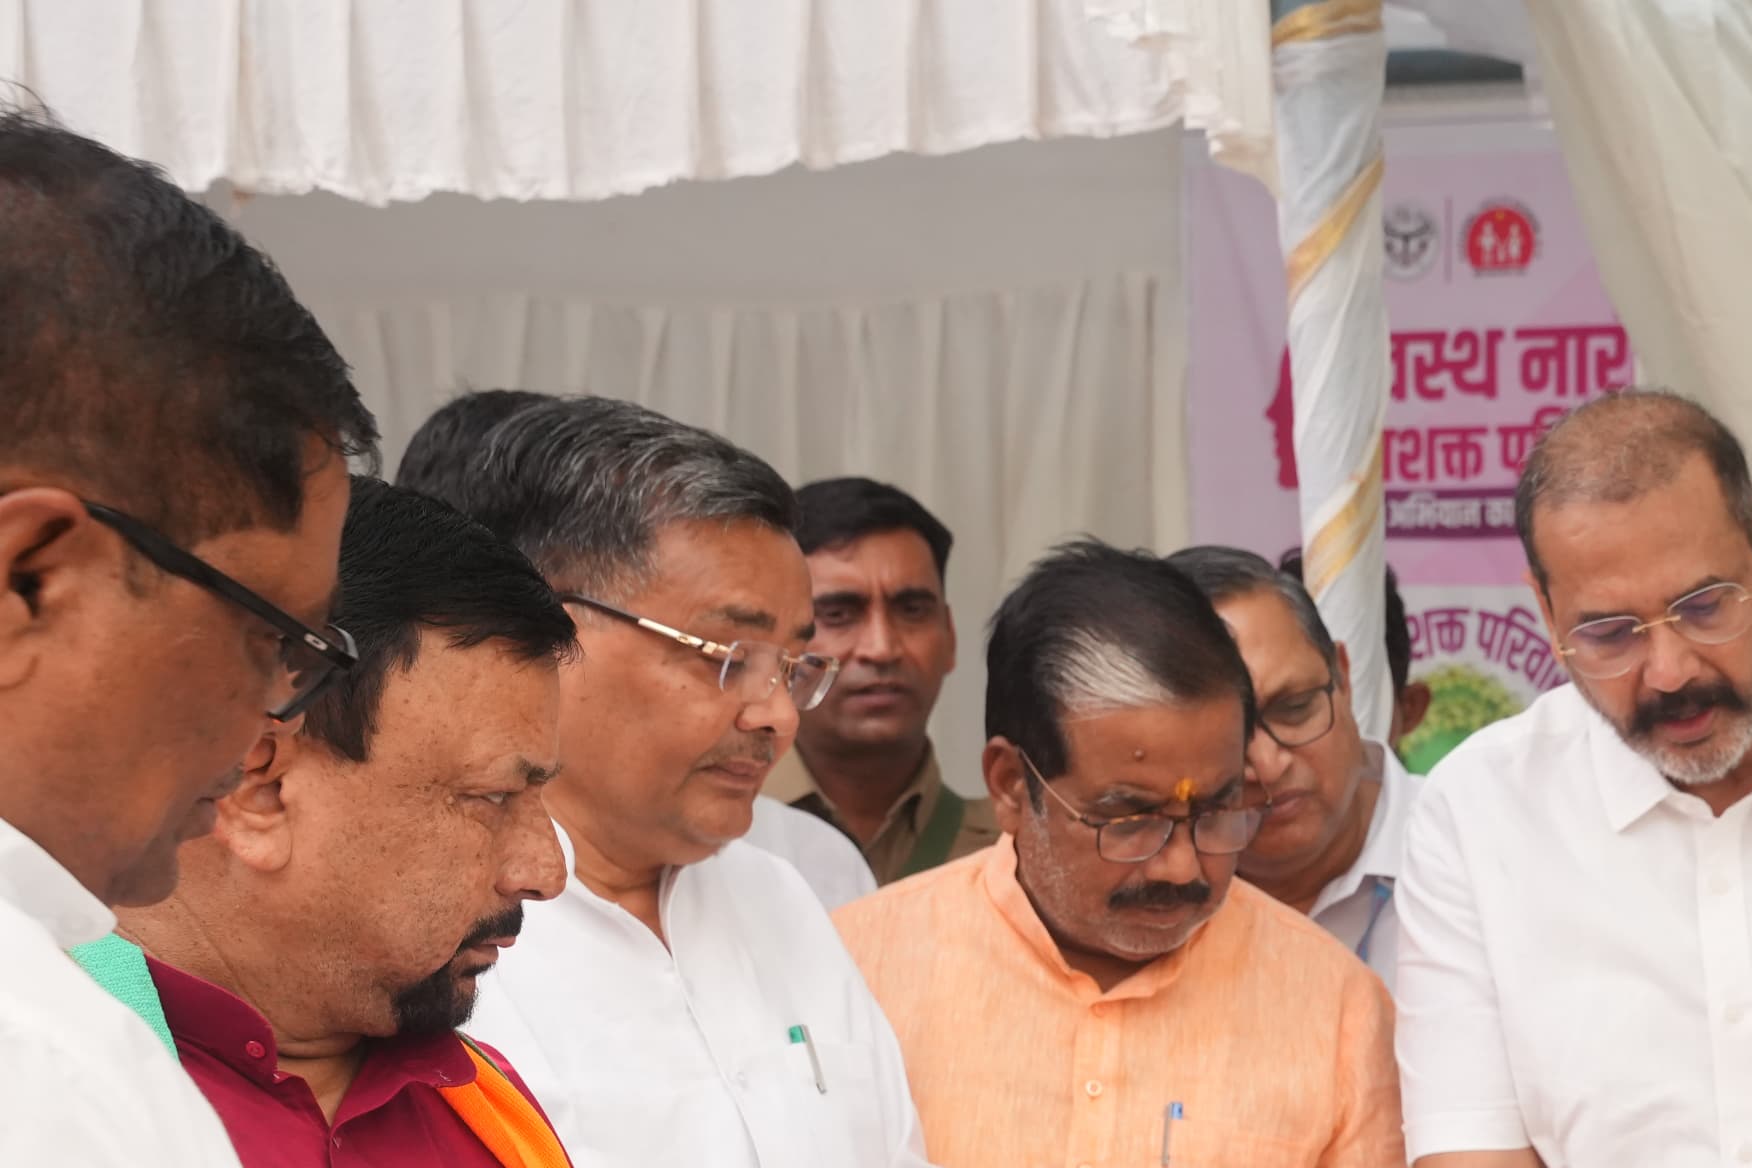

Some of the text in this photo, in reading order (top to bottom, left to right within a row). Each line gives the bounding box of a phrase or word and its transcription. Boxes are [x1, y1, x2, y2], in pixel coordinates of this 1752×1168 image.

[1391, 326, 1628, 400] वस्थ नार
[1405, 608, 1469, 658] शक्त
